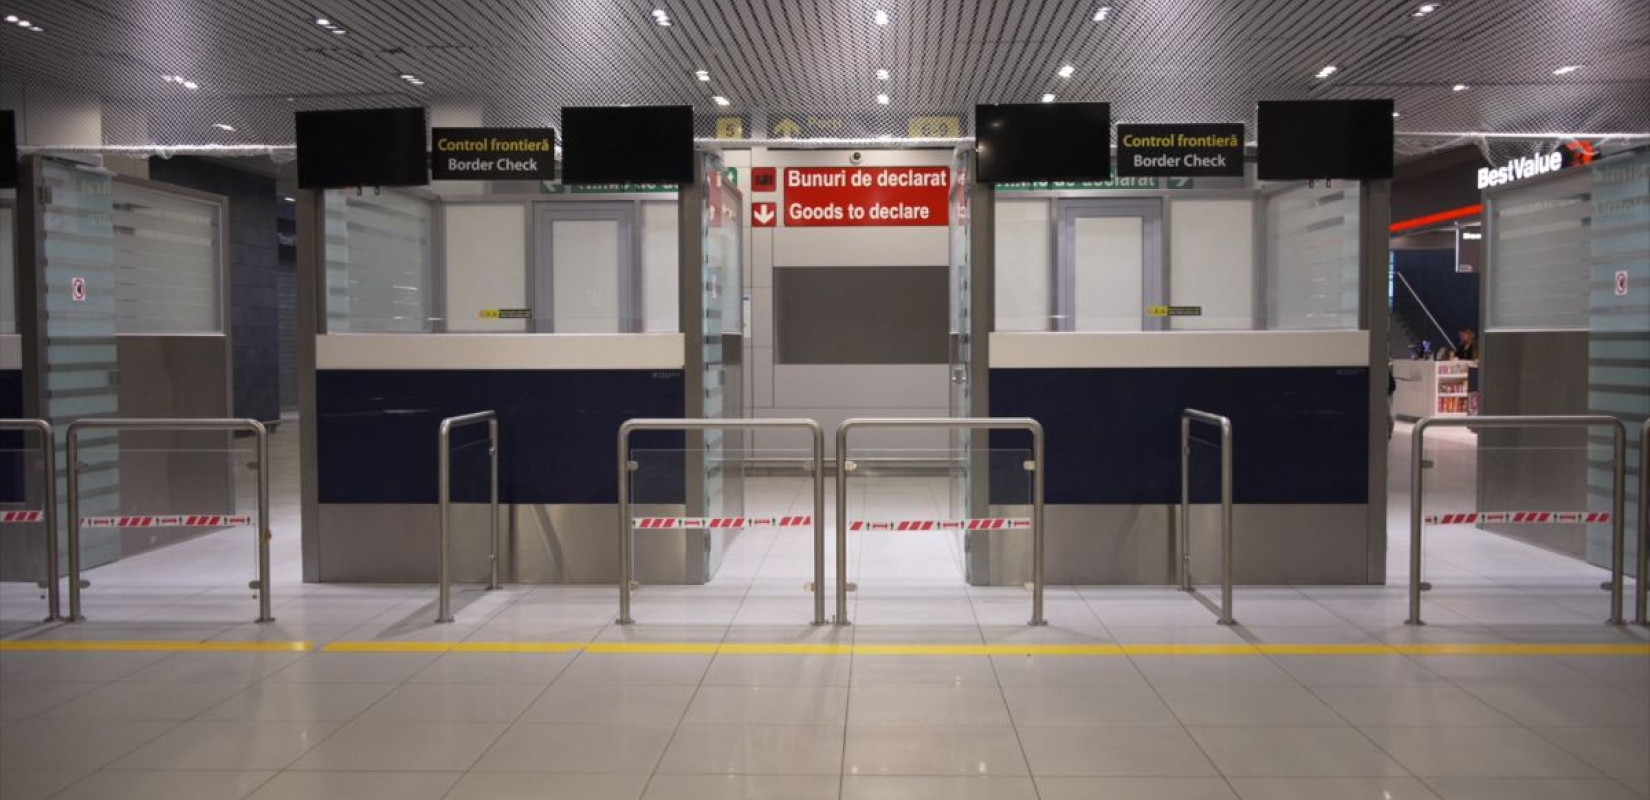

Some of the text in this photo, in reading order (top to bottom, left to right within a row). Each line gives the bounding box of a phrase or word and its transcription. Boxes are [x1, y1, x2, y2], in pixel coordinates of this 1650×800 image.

[438, 138, 550, 152] Control frontieră
[1122, 134, 1239, 148] Control frontieră
[448, 158, 539, 171] Border Check
[1133, 154, 1227, 168] Border Check
[788, 169, 847, 187] Bunuri
[850, 169, 873, 187] de
[876, 169, 947, 187] declarat
[789, 203, 930, 220] Goods to declare
